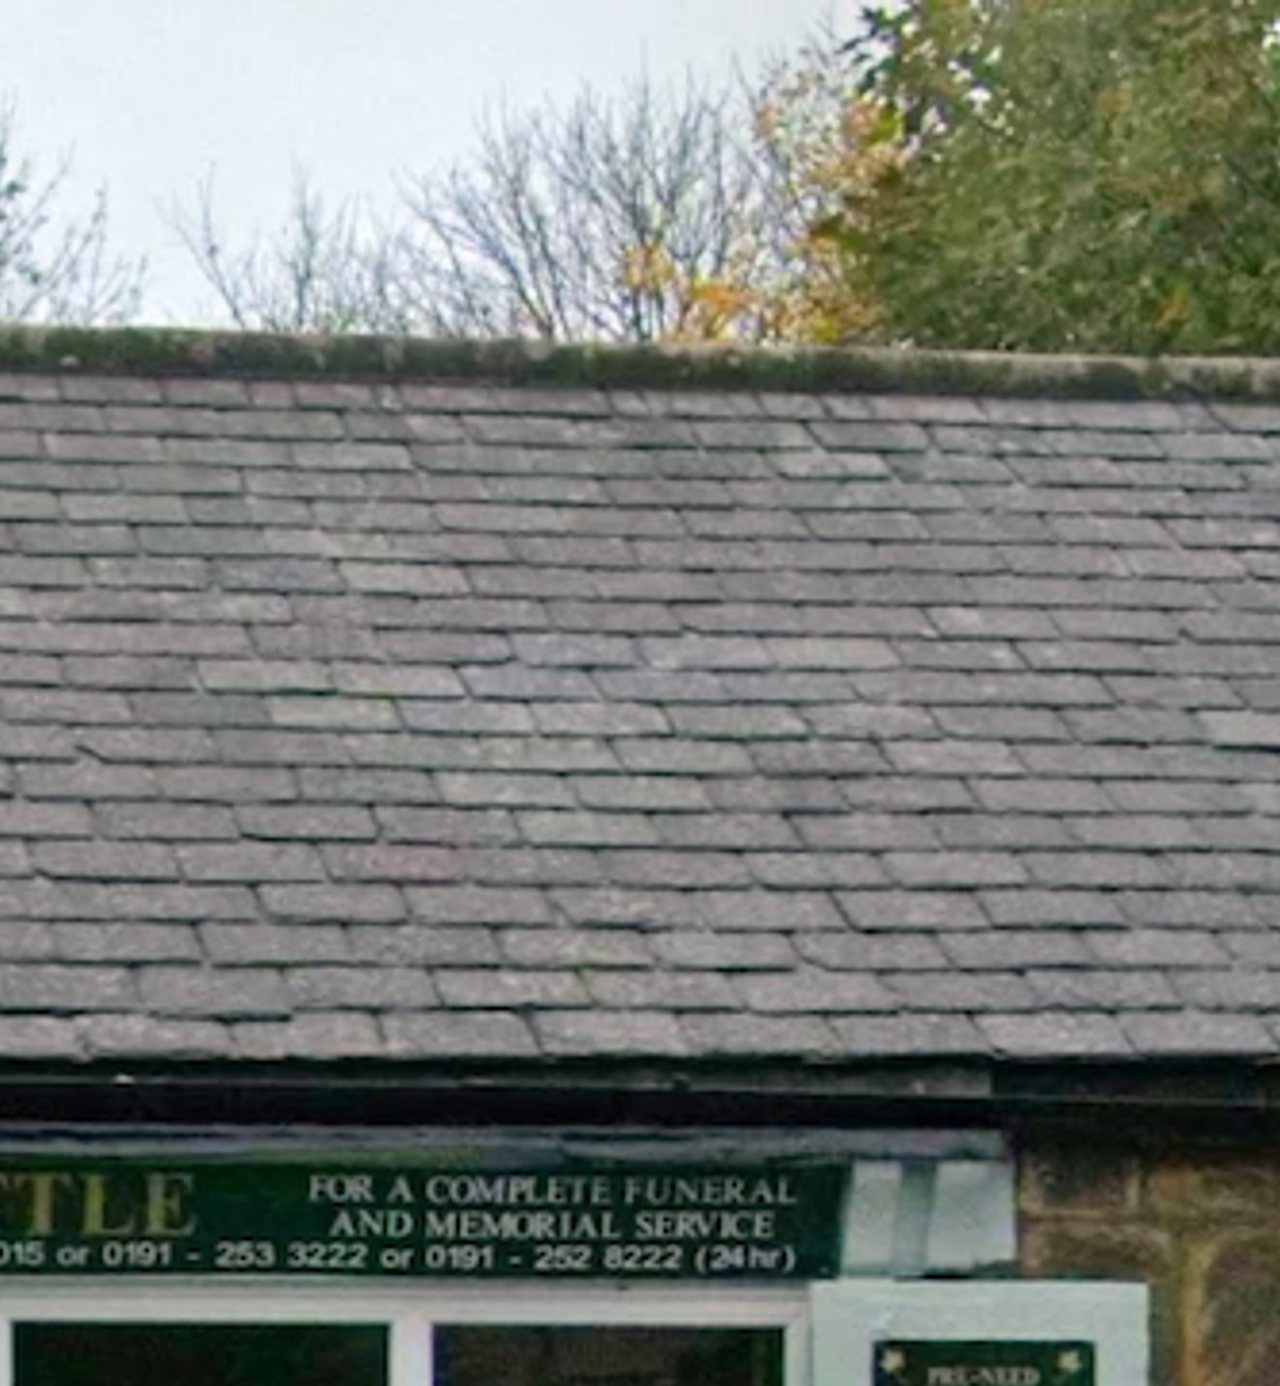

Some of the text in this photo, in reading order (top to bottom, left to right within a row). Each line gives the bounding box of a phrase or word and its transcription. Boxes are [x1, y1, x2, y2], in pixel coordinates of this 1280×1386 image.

[308, 1174, 799, 1205] FOR A COMPLETE FUNERAL
[329, 1209, 775, 1239] AND MEMORIAL SERVICE
[56, 1246, 91, 1267] or
[102, 1240, 172, 1267] 0191
[214, 1241, 276, 1268] 253
[286, 1242, 368, 1269] 3222
[380, 1248, 414, 1269] or
[425, 1243, 493, 1270] 0191
[534, 1243, 592, 1270] 252
[603, 1244, 684, 1271] 8222
[694, 1243, 797, 1274] (24hr)
